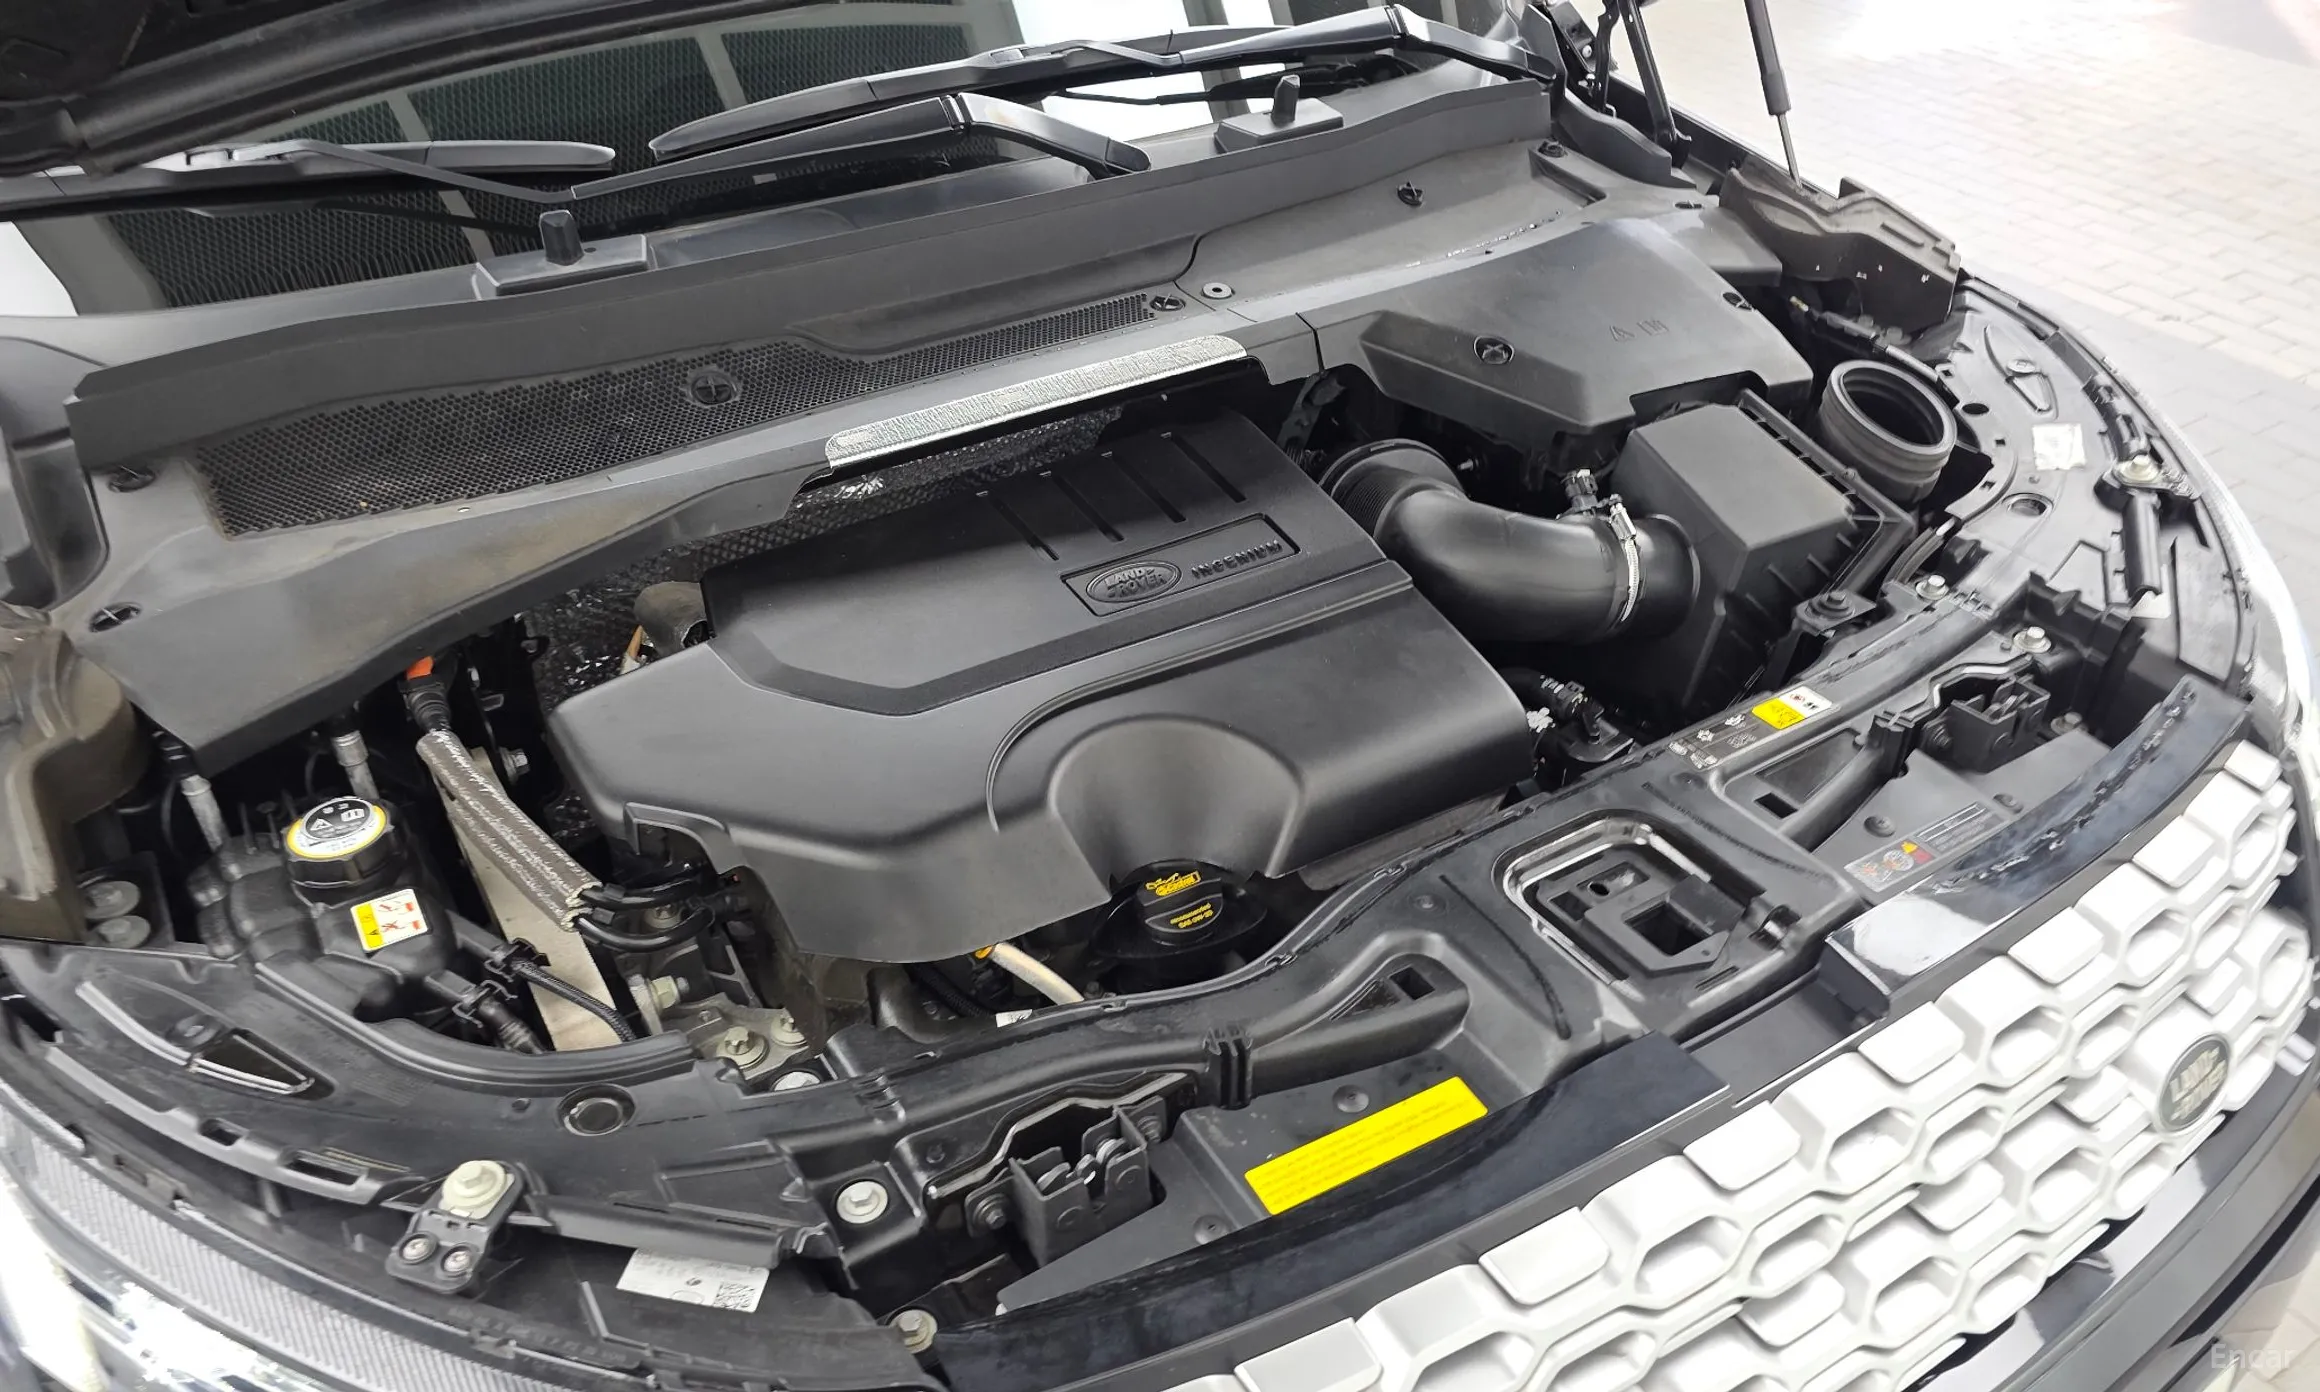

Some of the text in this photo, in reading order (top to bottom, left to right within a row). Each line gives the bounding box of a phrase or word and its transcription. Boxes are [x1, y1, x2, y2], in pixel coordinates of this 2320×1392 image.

[1191, 539, 1283, 579] INGENIUM
[1104, 566, 1146, 589] LAND
[1116, 574, 1168, 598] ROVER
[2169, 1048, 2216, 1104] LAND
